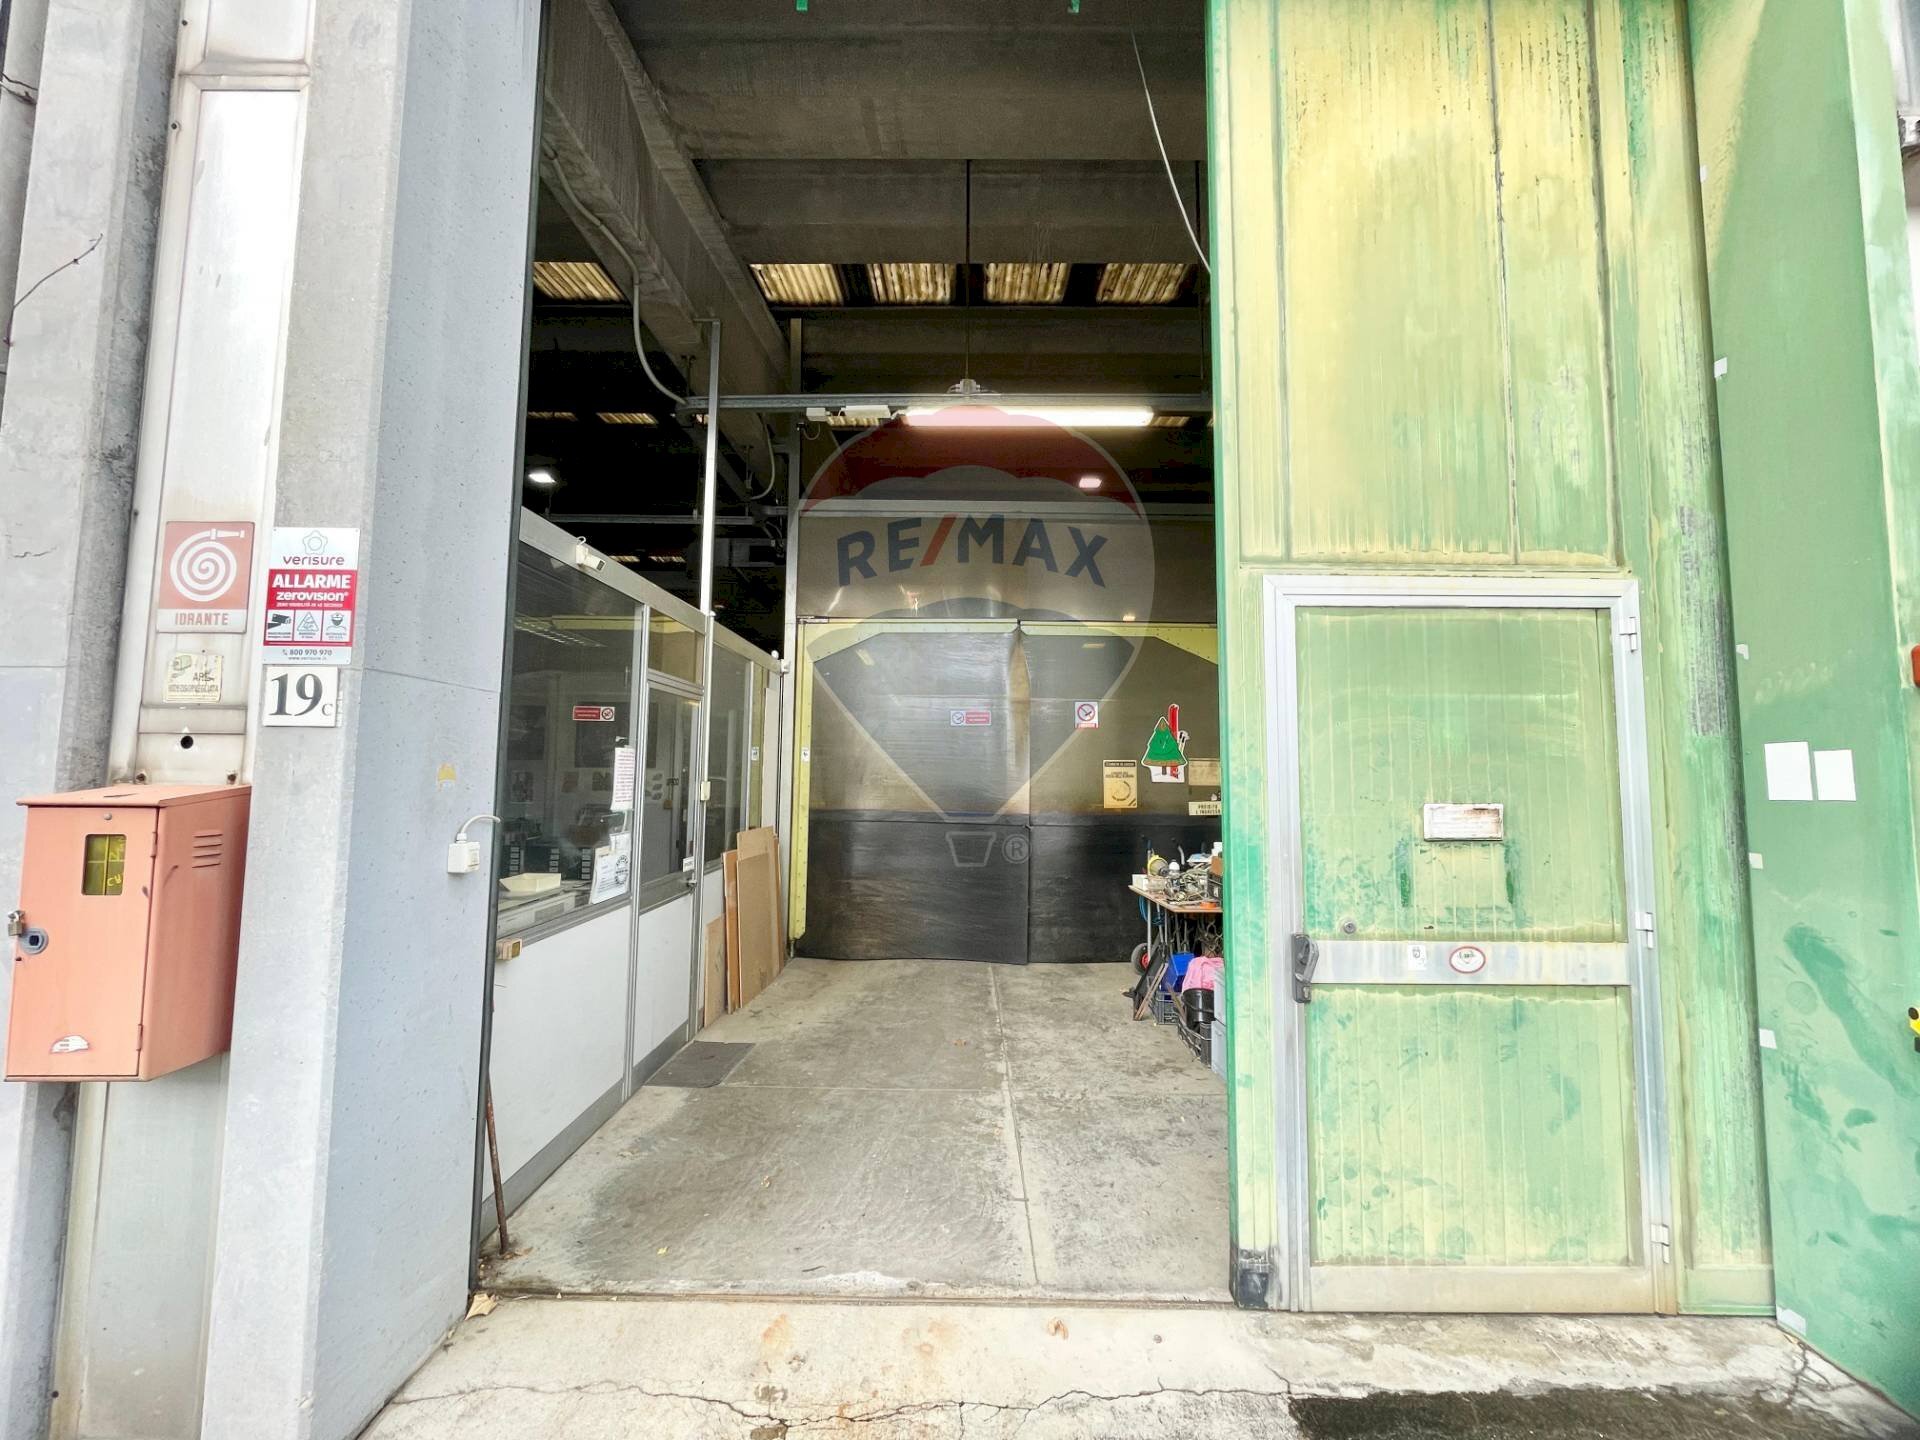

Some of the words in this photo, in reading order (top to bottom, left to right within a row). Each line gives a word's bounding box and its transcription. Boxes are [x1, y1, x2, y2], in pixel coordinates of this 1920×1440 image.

[283, 556, 345, 566] verisure
[272, 574, 352, 589] ALLARME
[175, 613, 229, 626] IDRANTE
